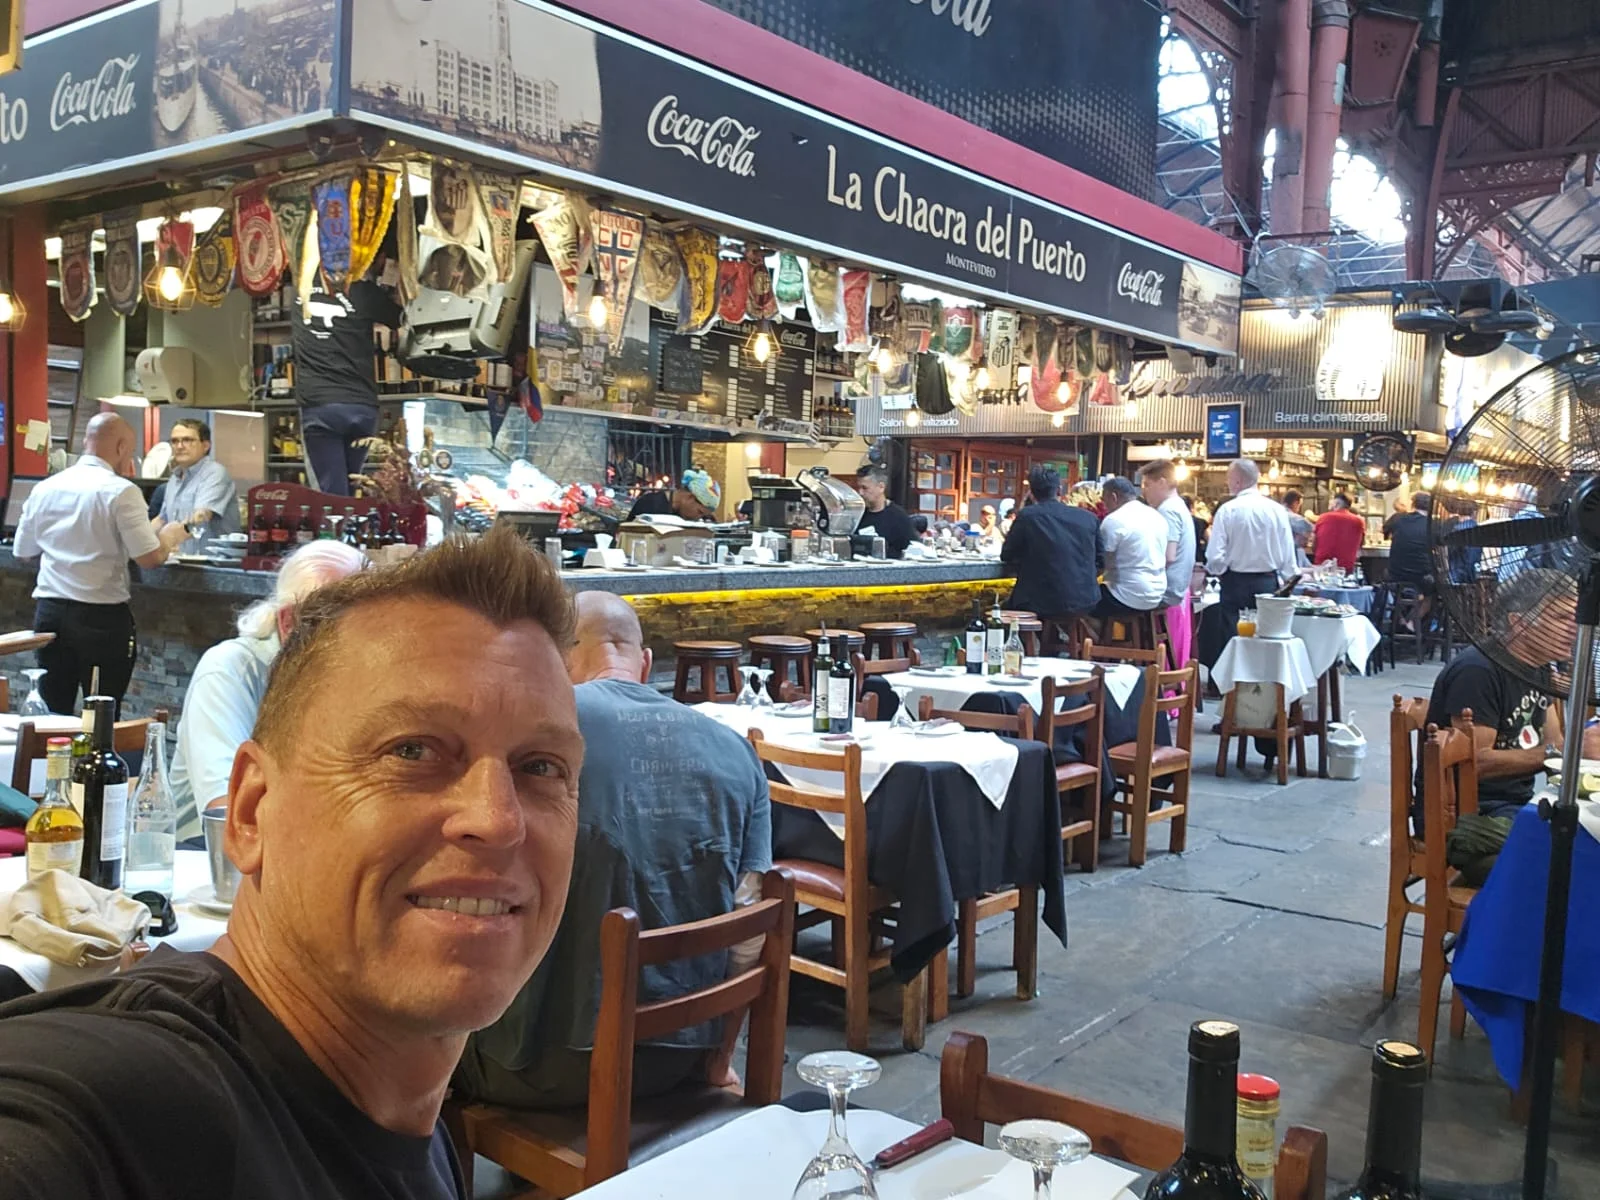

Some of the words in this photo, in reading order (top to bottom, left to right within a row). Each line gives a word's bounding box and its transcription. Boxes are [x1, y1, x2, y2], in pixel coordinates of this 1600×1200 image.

[50, 52, 141, 131] Coca-Cola
[647, 95, 761, 177] Coca-Cola
[827, 144, 863, 212] La
[874, 166, 967, 246] Chacra
[975, 206, 1012, 260] del
[1018, 217, 1087, 282] Puerto
[1117, 262, 1166, 307] Coca-Cola
[1275, 410, 1308, 423] Barra
[1312, 410, 1389, 423] climatizada
